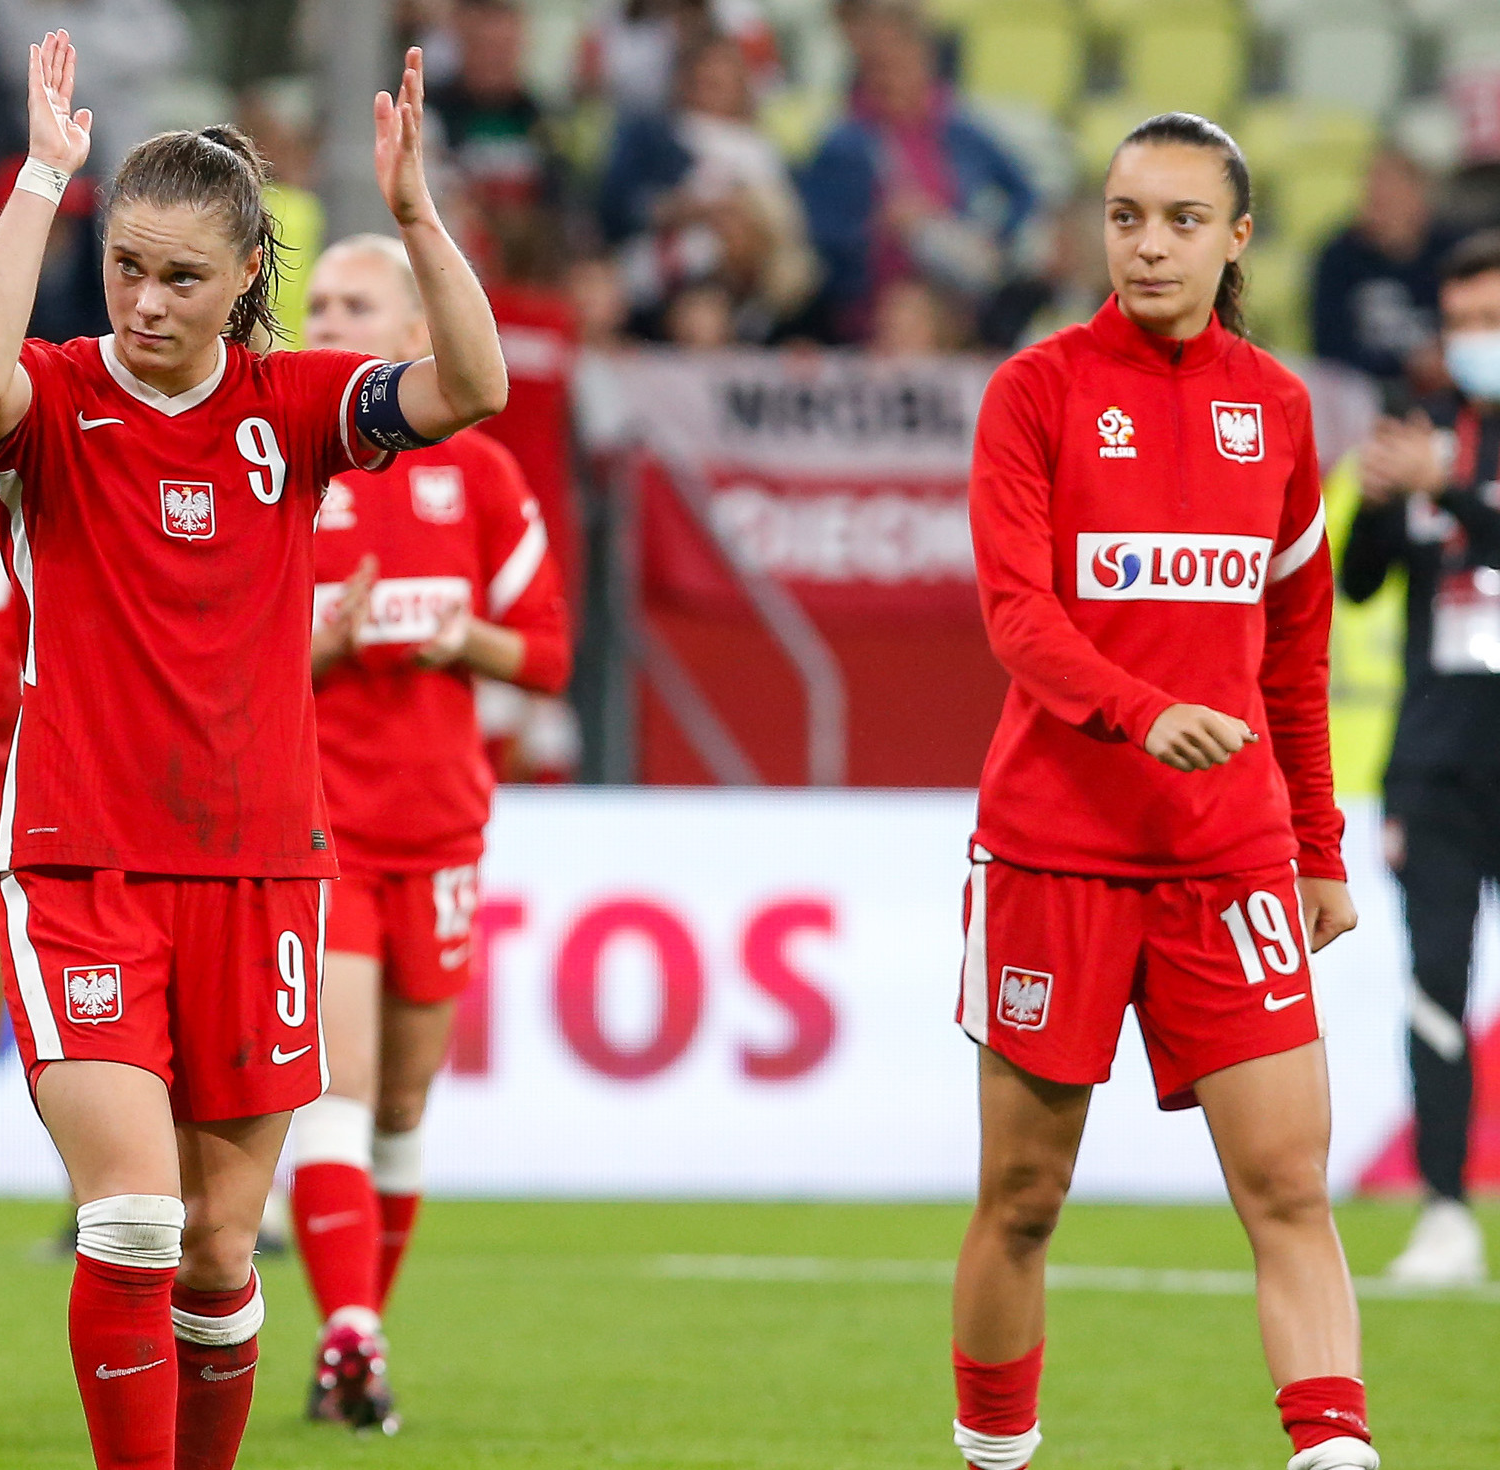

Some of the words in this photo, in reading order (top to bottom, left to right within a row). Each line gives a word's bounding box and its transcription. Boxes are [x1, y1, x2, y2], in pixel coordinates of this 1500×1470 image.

[360, 390, 370, 414] NO
[362, 372, 376, 390] TO
[235, 417, 287, 505] 9
[1098, 446, 1138, 460] POLSKA
[1150, 546, 1262, 590] LOTOS
[1220, 889, 1301, 985] 19
[276, 930, 306, 1028] 9
[451, 897, 838, 1080] TOS
